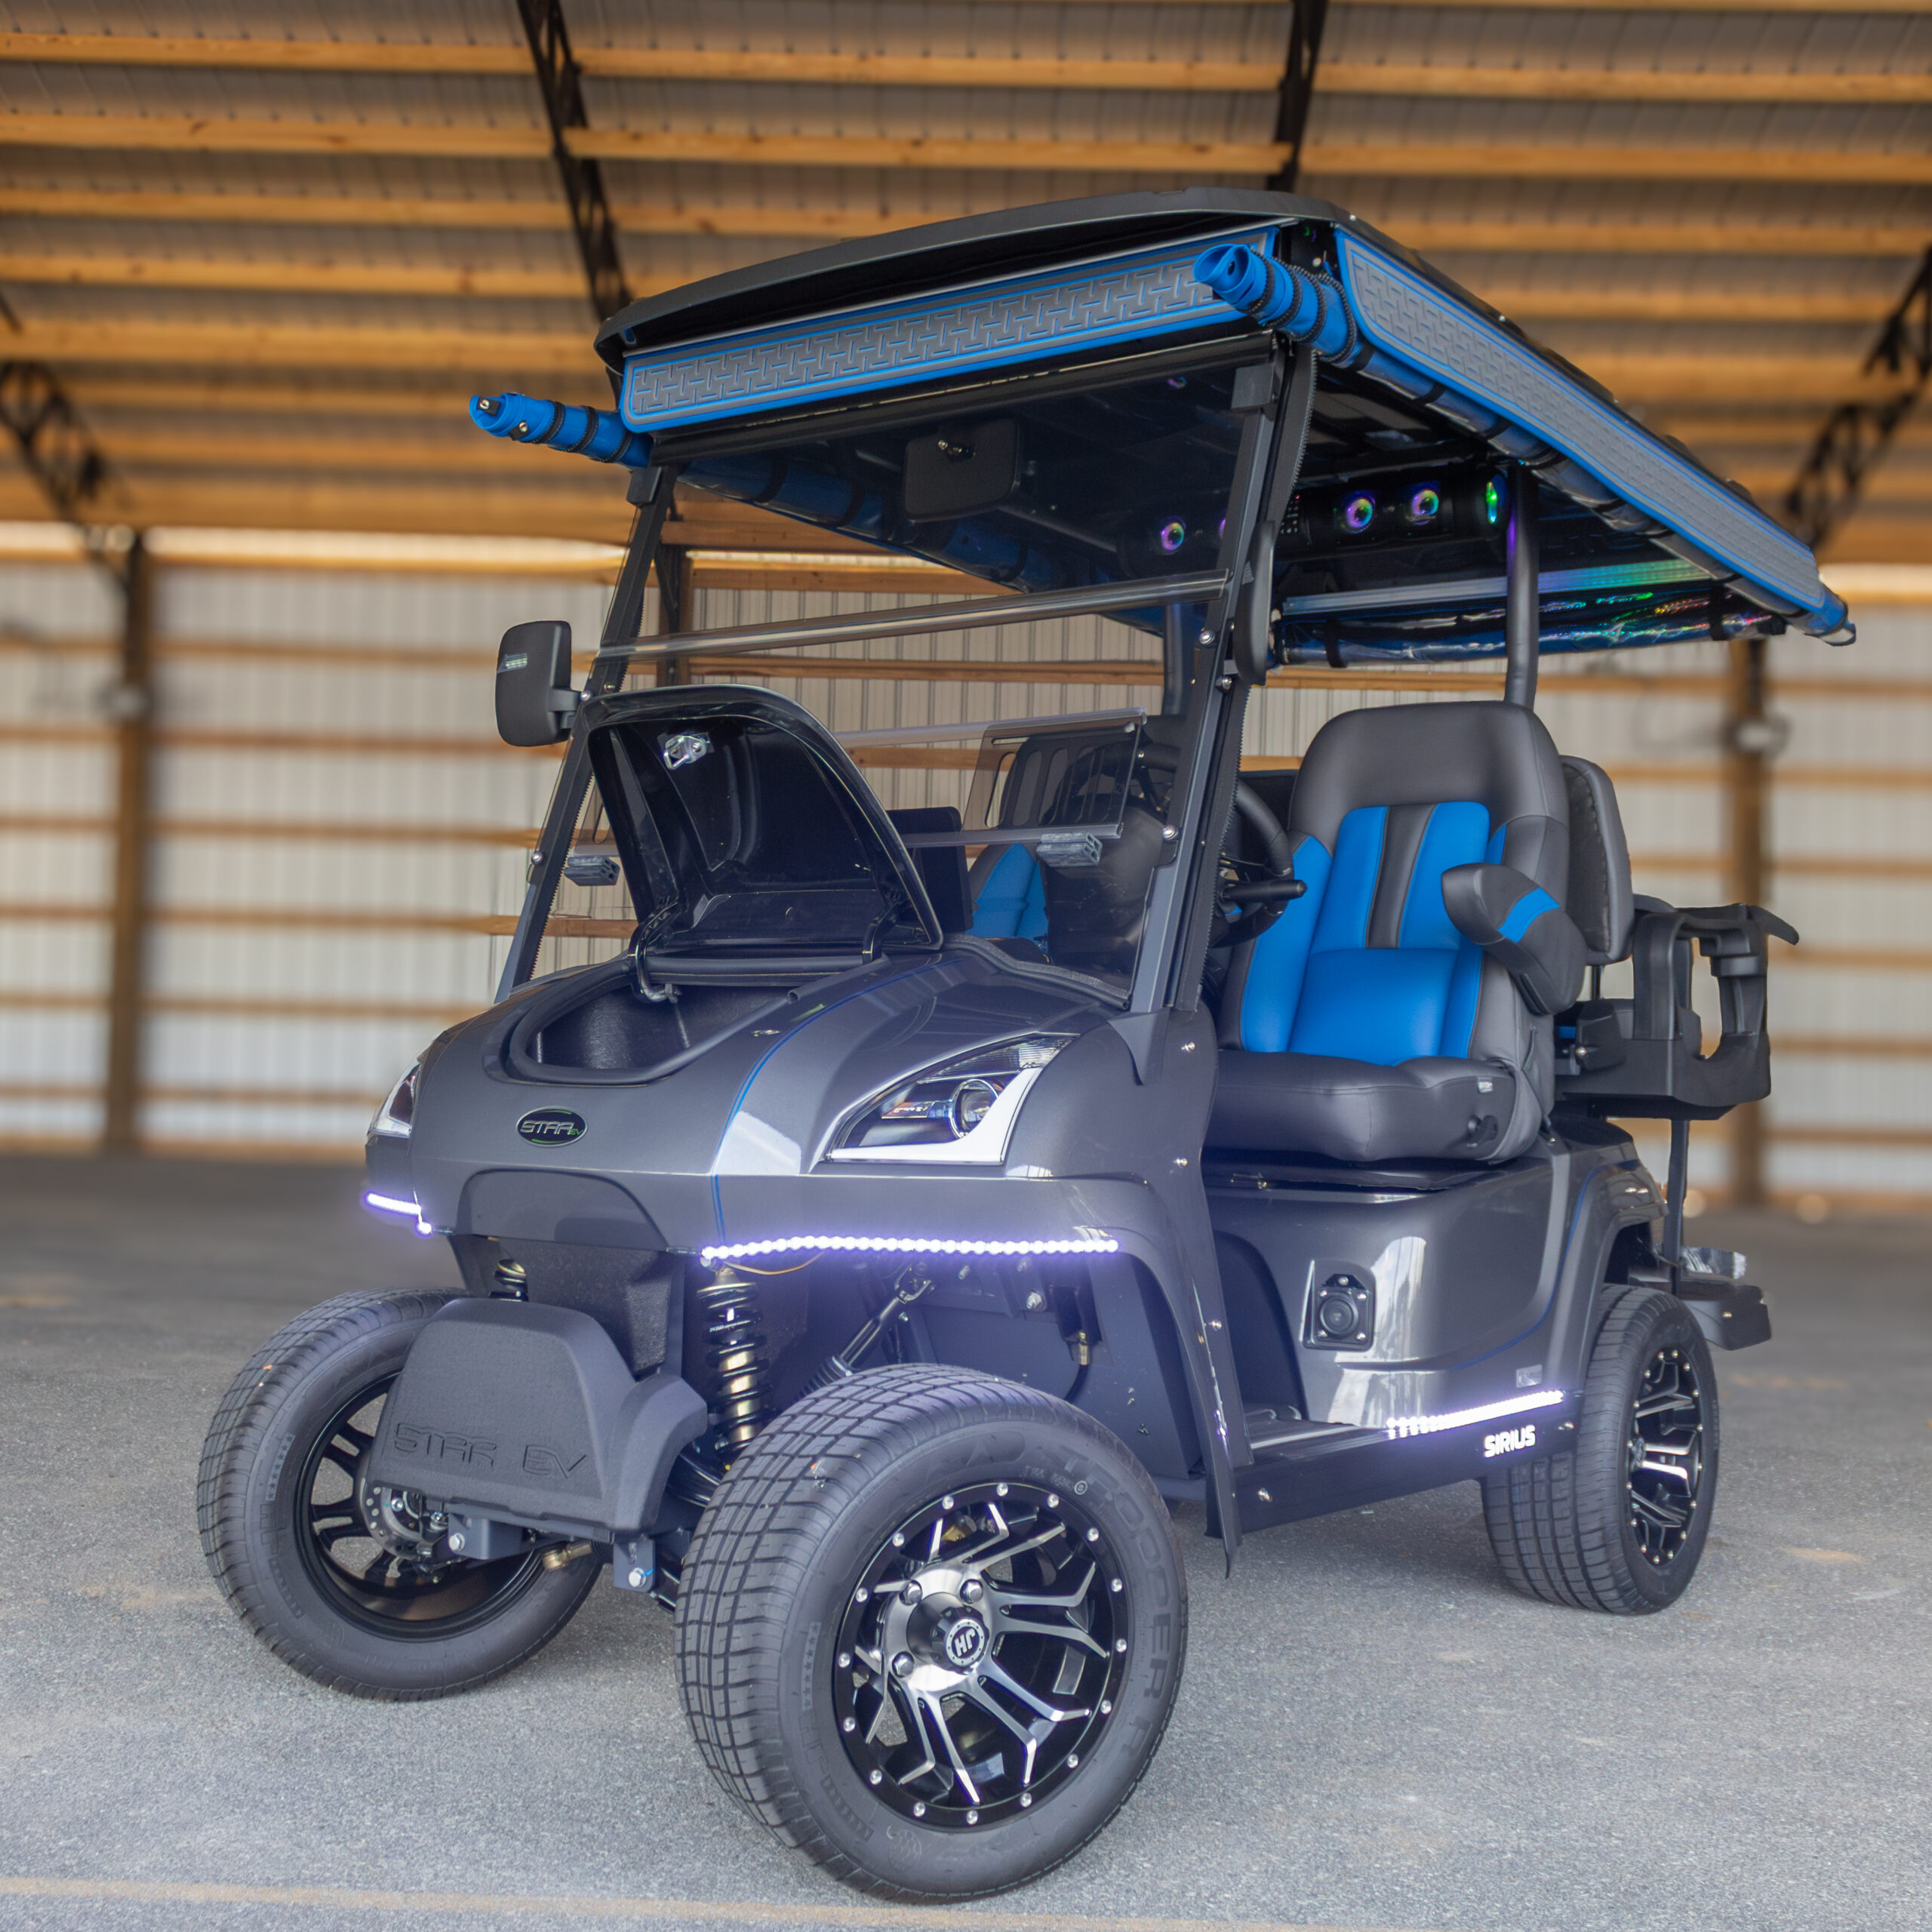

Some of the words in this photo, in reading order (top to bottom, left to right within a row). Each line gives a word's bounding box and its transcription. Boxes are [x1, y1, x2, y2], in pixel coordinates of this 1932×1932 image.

[520, 1120, 574, 1135] STAR
[393, 1422, 497, 1469] STAR
[522, 1444, 587, 1480] EV
[1484, 1424, 1536, 1458] SIRIUS
